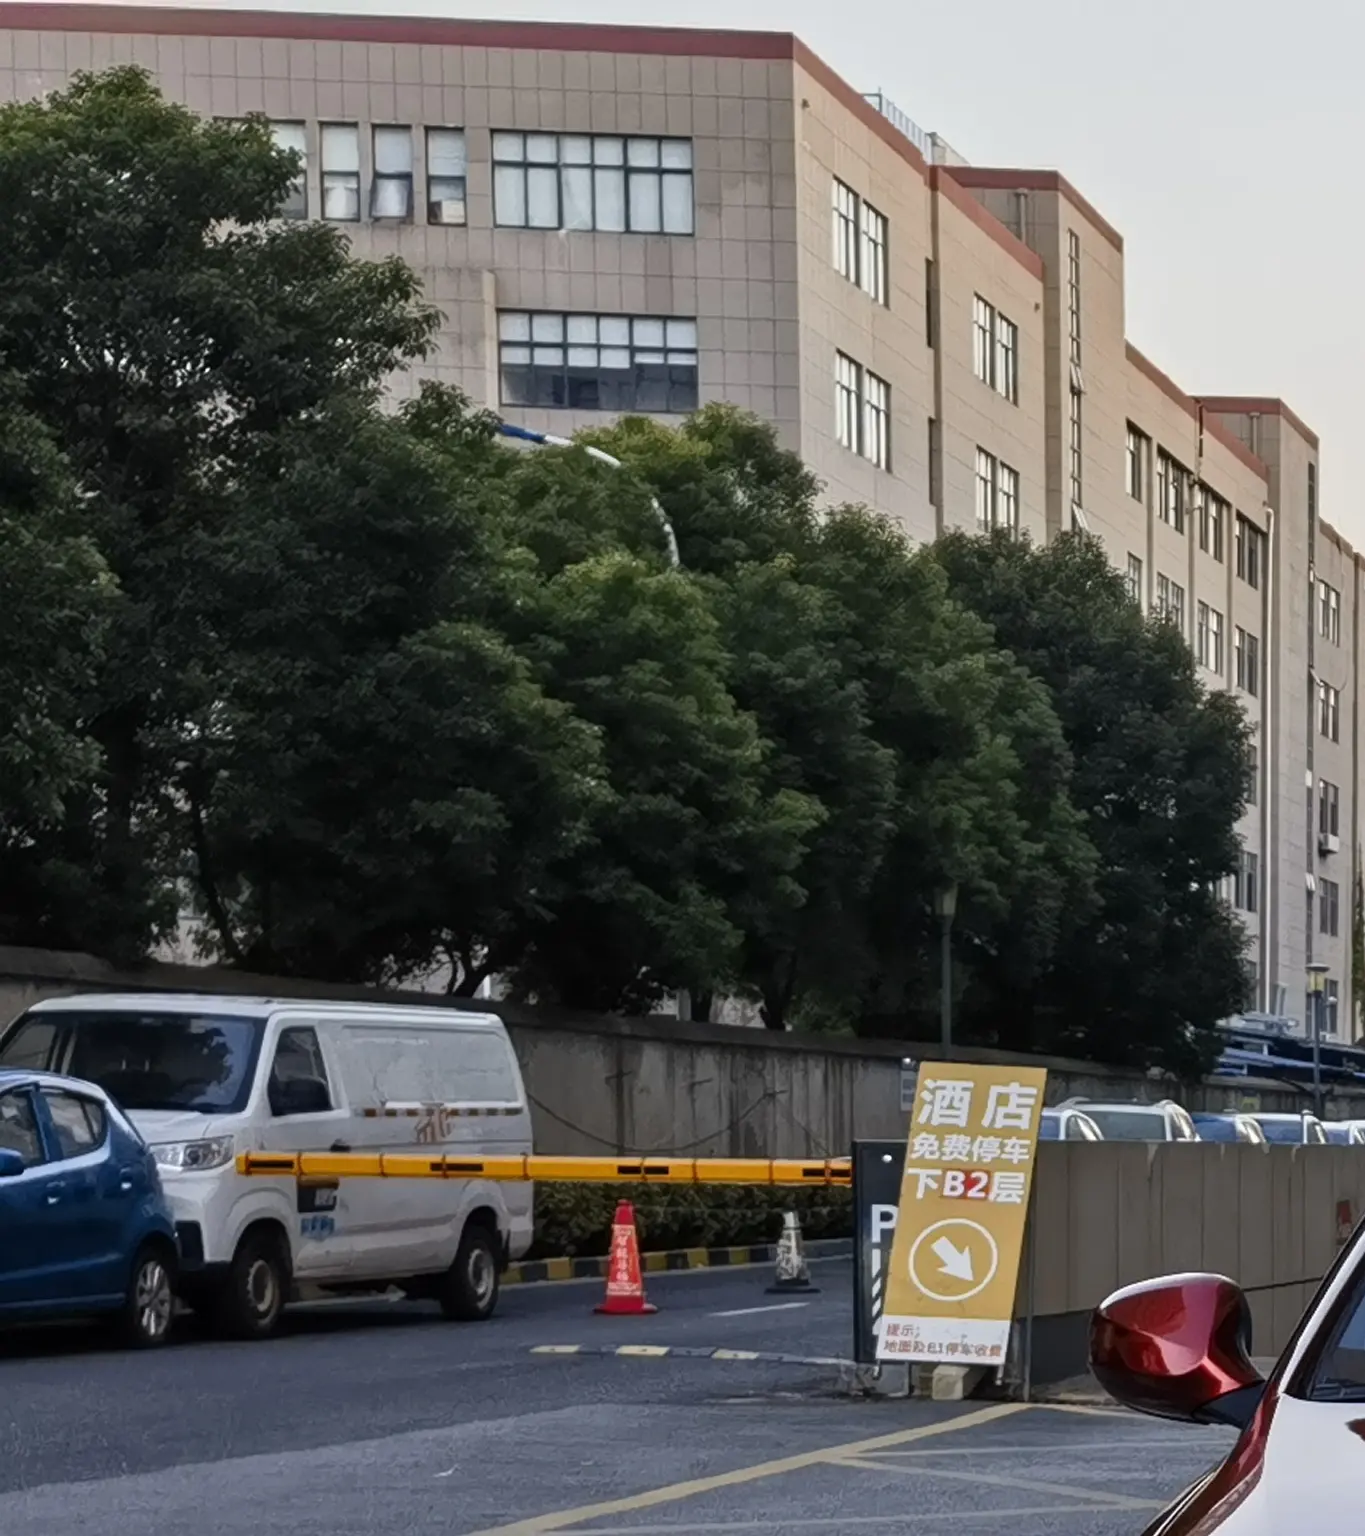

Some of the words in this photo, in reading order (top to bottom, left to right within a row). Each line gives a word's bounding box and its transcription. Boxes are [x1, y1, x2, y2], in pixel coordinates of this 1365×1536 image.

[917, 1079, 1037, 1130] 酒店
[910, 1132, 1030, 1165] 免费停车
[907, 1167, 1026, 1204] 下B2层
